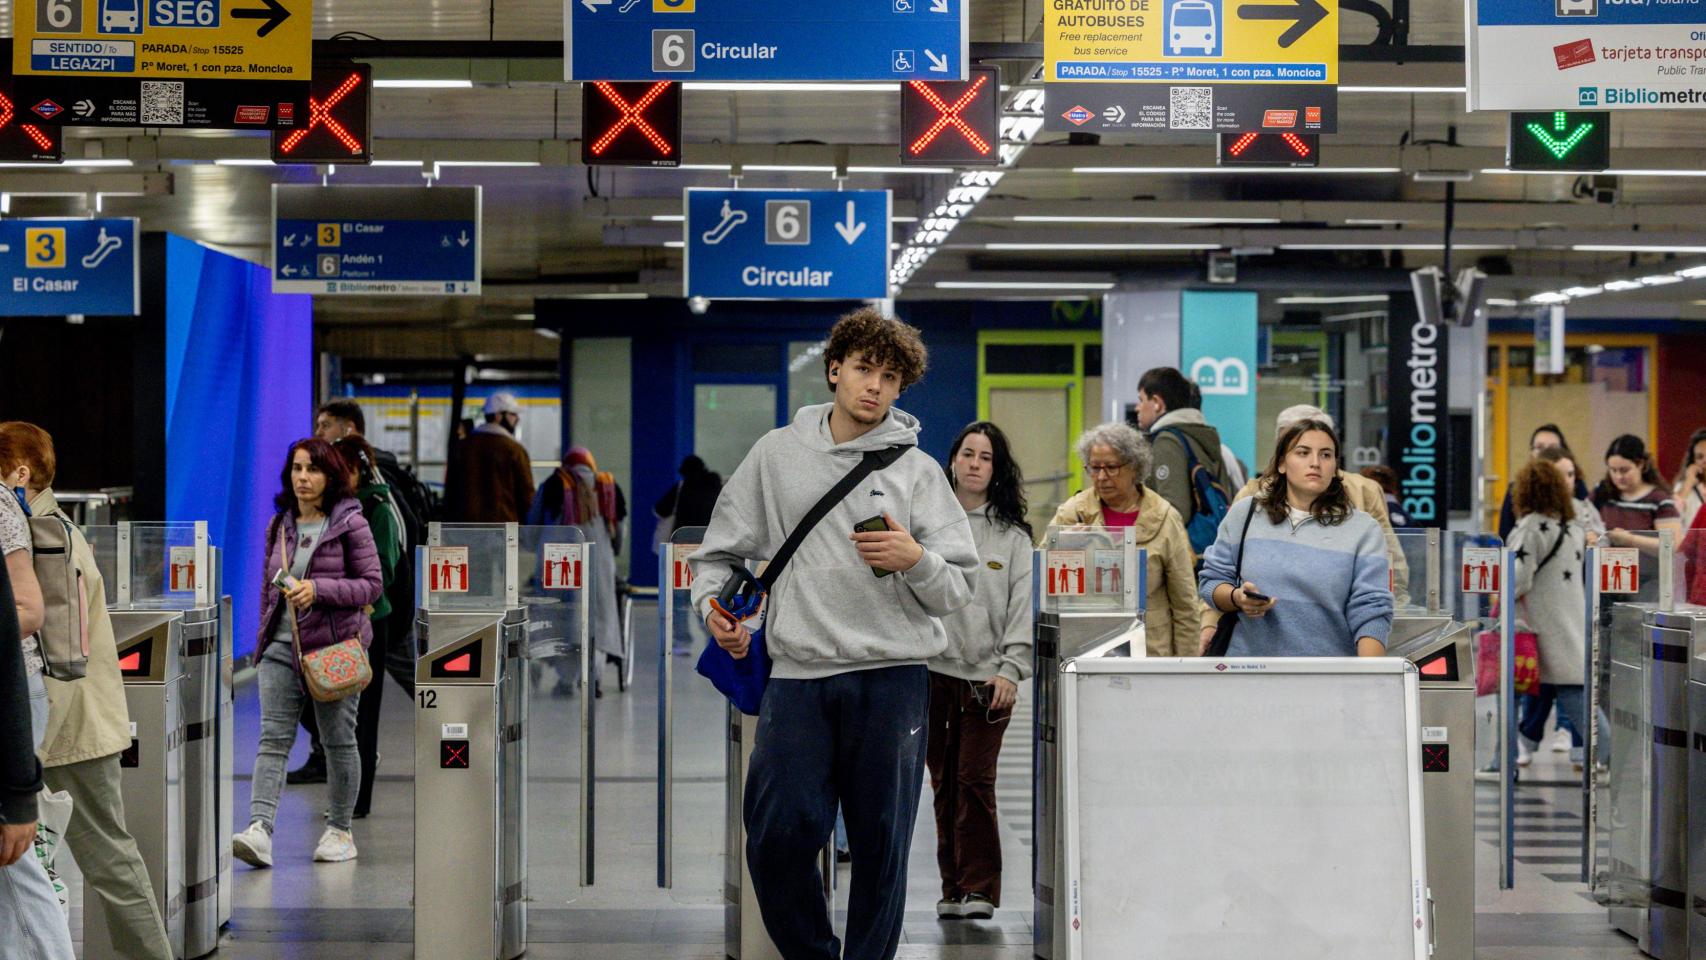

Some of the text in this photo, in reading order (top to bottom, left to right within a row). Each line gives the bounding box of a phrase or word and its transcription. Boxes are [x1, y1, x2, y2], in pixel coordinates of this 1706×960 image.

[155, 0, 214, 26] SE6
[1053, 0, 1149, 11] GRATUITO DE
[47, 0, 73, 28] 6
[1057, 16, 1145, 27] AUTOBUSES
[1059, 32, 1143, 44] Free replacement
[213, 45, 244, 55] 15525
[662, 34, 685, 67] 6
[701, 42, 778, 59] Circular
[1074, 46, 1128, 56] bus service
[1601, 46, 1651, 62] tarjeta
[51, 57, 116, 71] LEGAZPI
[156, 61, 190, 72] Moret,
[192, 62, 198, 72] 1
[202, 64, 221, 73] con
[224, 64, 245, 75] pza.
[248, 63, 293, 74] Moncloa
[1657, 65, 1687, 76] Public
[1131, 67, 1162, 76] 15525
[1186, 67, 1219, 78] Moret,
[1222, 68, 1227, 77] 1
[1231, 69, 1250, 77] con
[1253, 69, 1274, 79] pza.
[1277, 68, 1321, 78] Moncloa
[343, 224, 384, 233] El Casar
[775, 205, 800, 239] 6
[323, 226, 335, 243] 3
[36, 233, 56, 262] 3
[322, 257, 334, 274] 6
[342, 254, 383, 264] Andén 1
[742, 265, 833, 287] Circular
[13, 277, 79, 292] El Casar
[340, 282, 396, 292] Bibliometro
[1402, 321, 1438, 520] Bibliometro
[417, 689, 438, 709] 12
